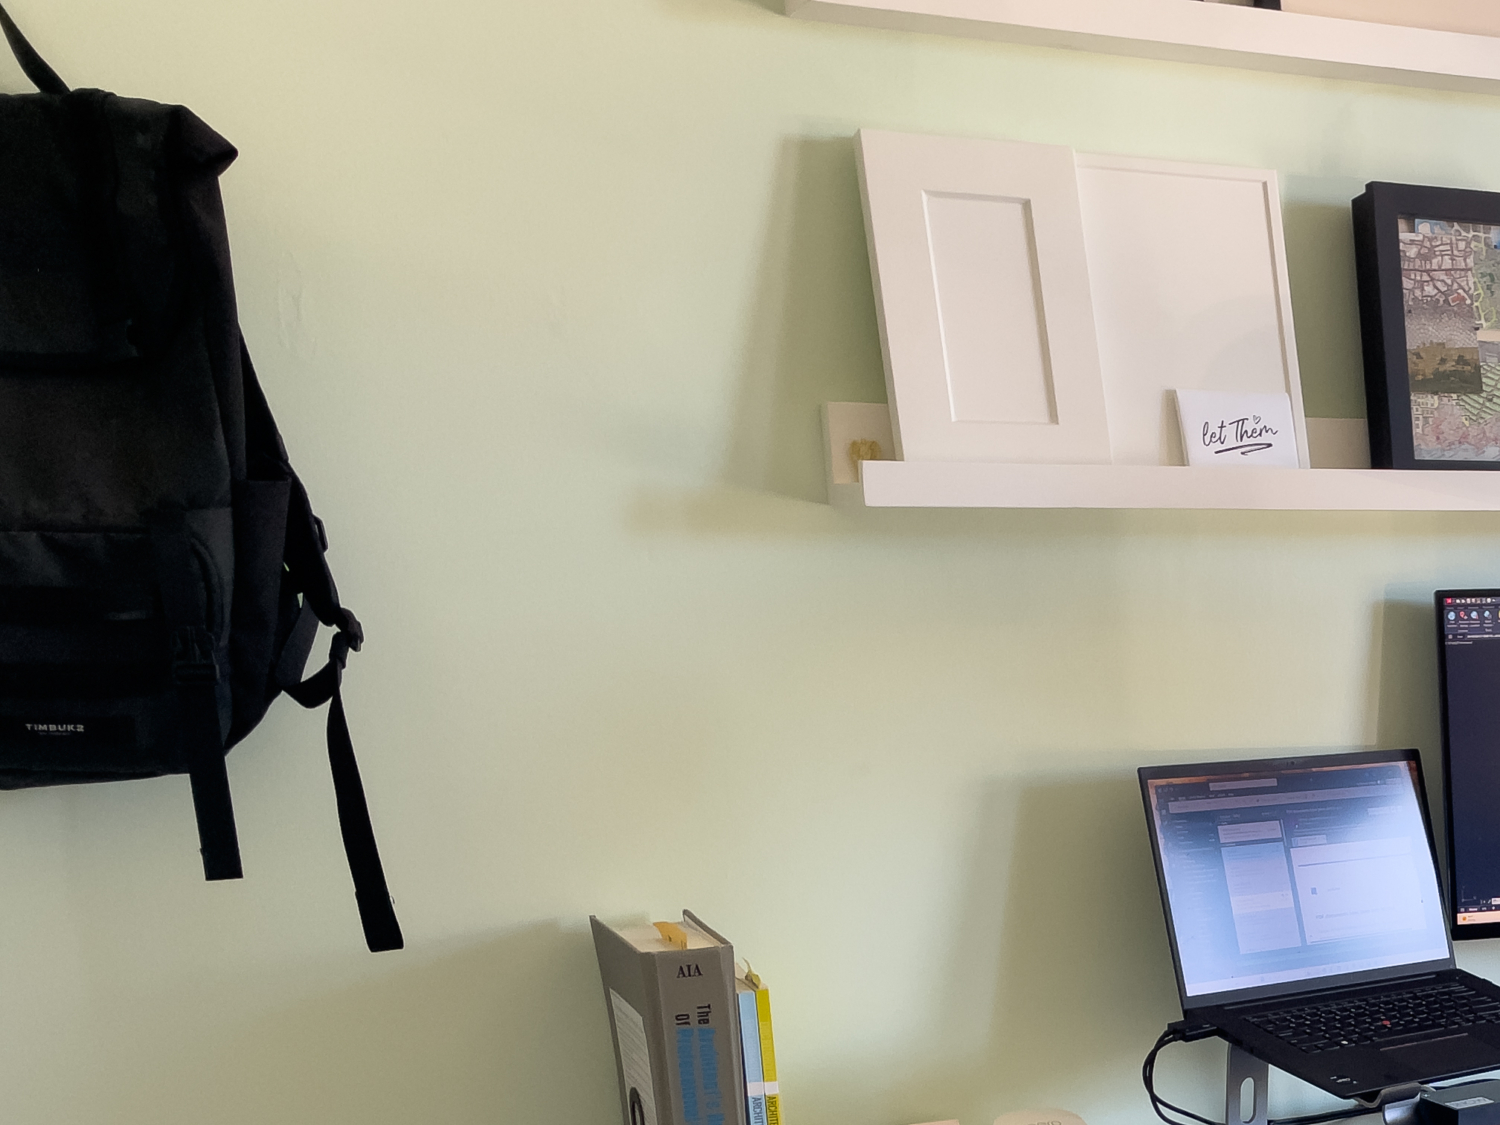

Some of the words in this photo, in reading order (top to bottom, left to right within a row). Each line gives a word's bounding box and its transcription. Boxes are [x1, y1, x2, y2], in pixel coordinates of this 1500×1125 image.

[25, 724, 84, 732] TIMBUK2
[676, 963, 703, 978] AIA
[675, 1013, 691, 1026] Of
[696, 1003, 712, 1025] The
